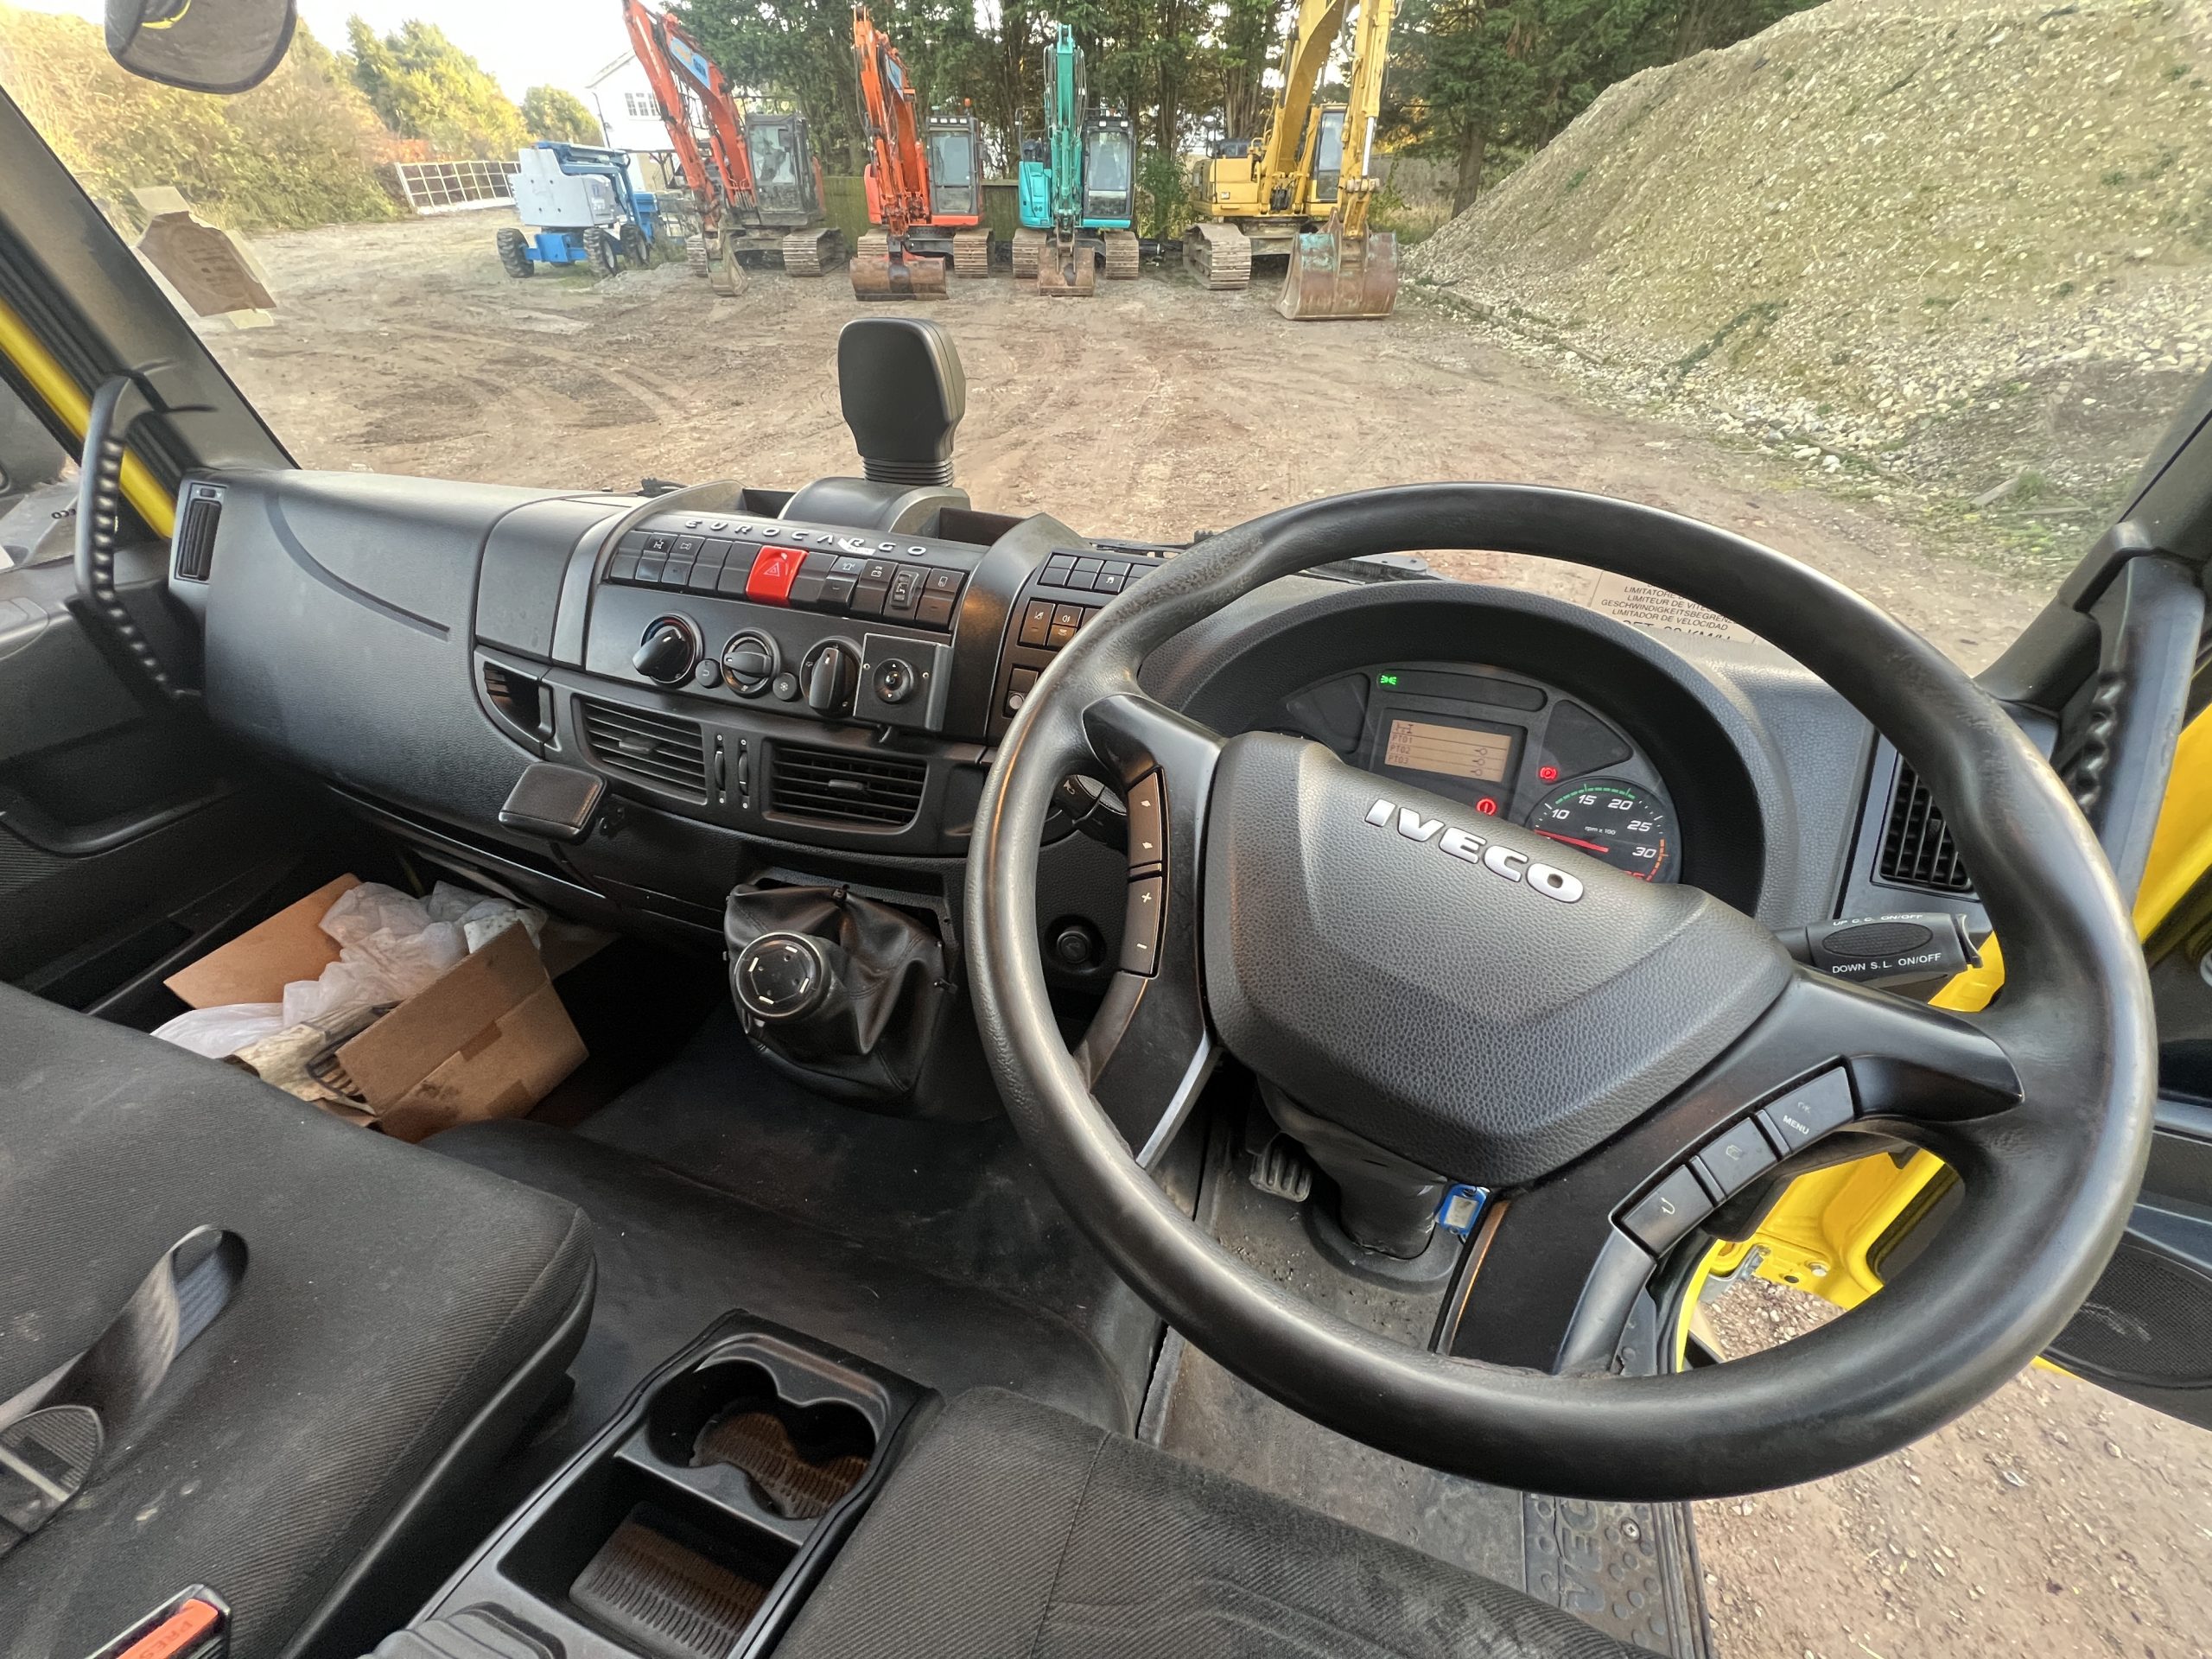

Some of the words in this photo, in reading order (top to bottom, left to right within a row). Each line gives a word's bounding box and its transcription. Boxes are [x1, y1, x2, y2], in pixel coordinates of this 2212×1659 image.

[685, 519, 927, 556] EUROCARGO
[1627, 594, 1669, 606] LIMITEUR
[1671, 600, 1685, 608] DE
[1612, 608, 1659, 620] LIMITADOR
[1676, 617, 1728, 631] VELOCIDAD
[1579, 794, 1597, 805] 15
[1608, 798, 1633, 810] 20
[1552, 809, 1570, 820] 10
[1627, 820, 1653, 832] 25
[1364, 798, 1584, 903] IVECO
[1632, 847, 1657, 858] 30
[1832, 963, 1866, 974] DOWN
[1898, 952, 1942, 966] ON/OFF
[1783, 1115, 1809, 1135] MENU
